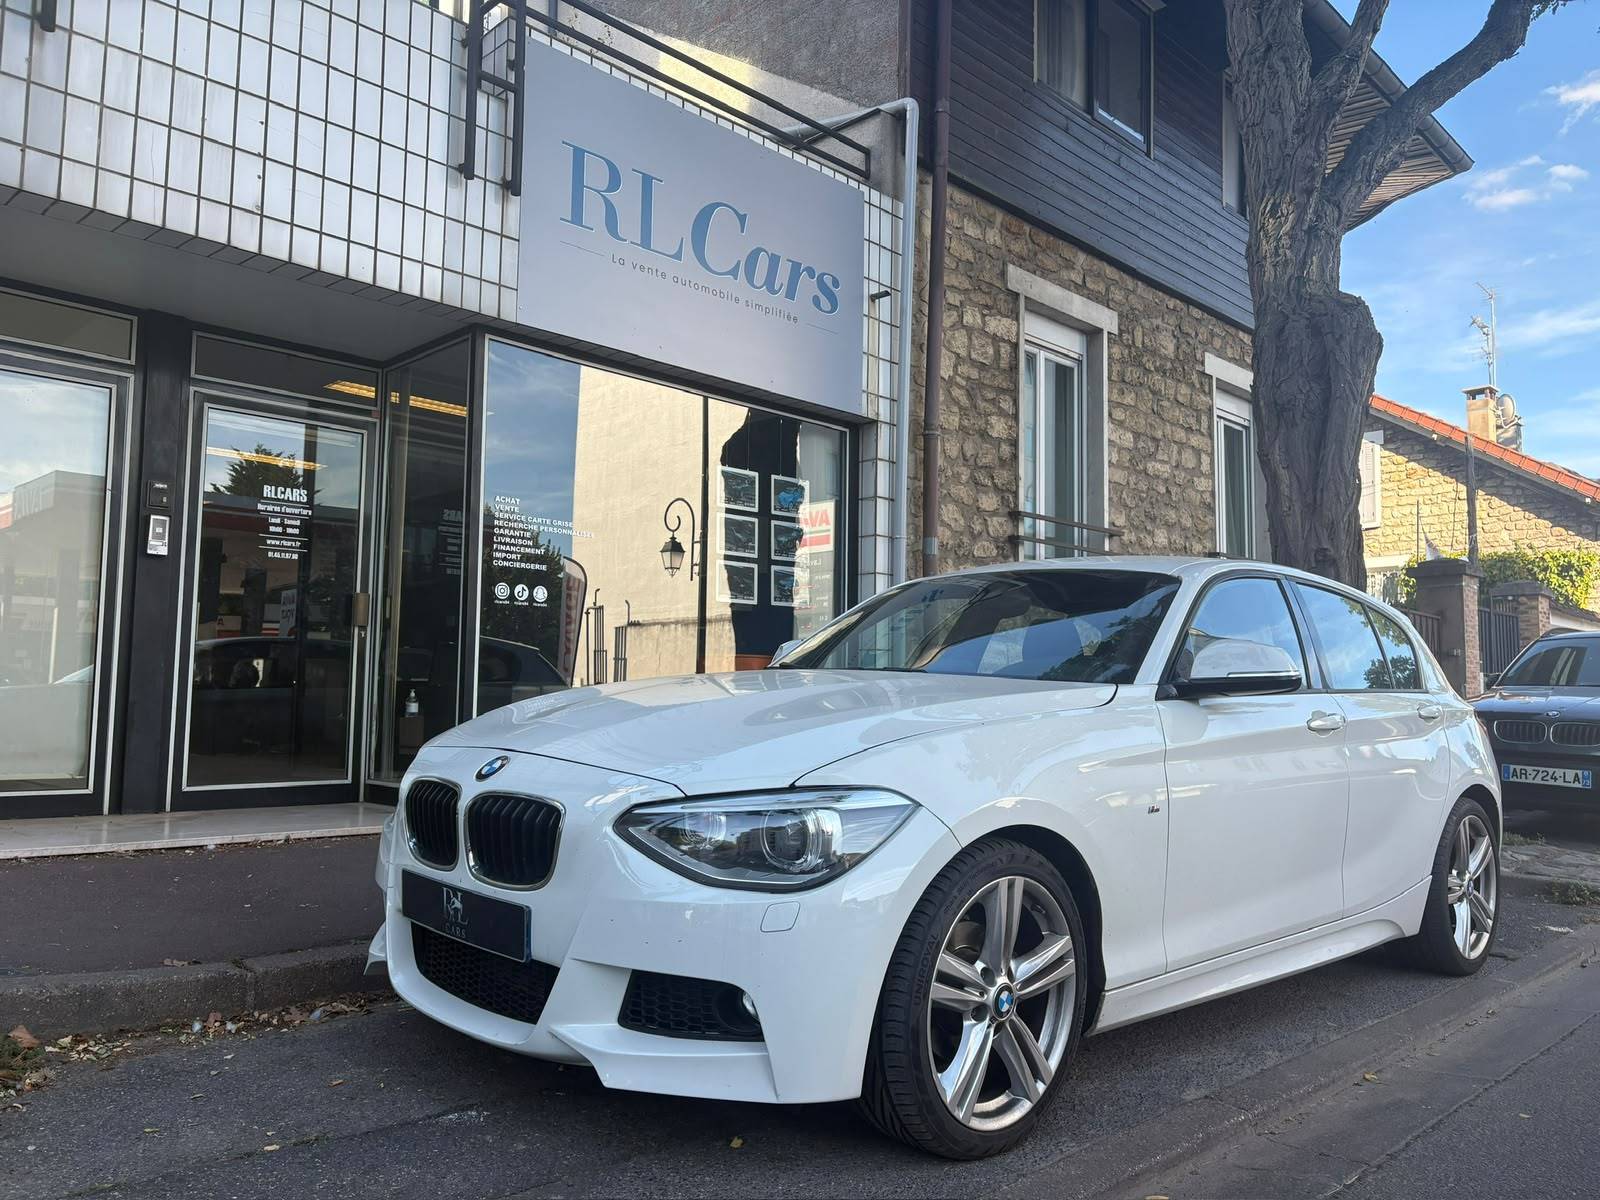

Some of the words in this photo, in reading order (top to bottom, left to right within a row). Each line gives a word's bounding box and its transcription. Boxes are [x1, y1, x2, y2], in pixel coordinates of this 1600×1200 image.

[611, 253, 625, 266] La
[631, 261, 667, 280] vente
[672, 275, 740, 304] automobile
[745, 298, 799, 323] simplifiée
[263, 484, 308, 502] RLCARS
[495, 495, 520, 505] ACHAT
[494, 504, 520, 513] VENTE
[494, 512, 526, 521] SERVICE
[527, 516, 551, 525] CARTE
[552, 520, 575, 528] GRISE
[494, 520, 539, 531] RECHERCHE
[493, 527, 531, 538] GARANTIE
[493, 536, 533, 546] LIVRAISON
[493, 544, 545, 555] FINANCEMENT
[492, 552, 521, 560] IMPORT
[492, 560, 547, 571] CONCIERGERIE
[1511, 767, 1581, 785] AR-724-LA
[912, 932, 940, 1006] UNIROYAL
